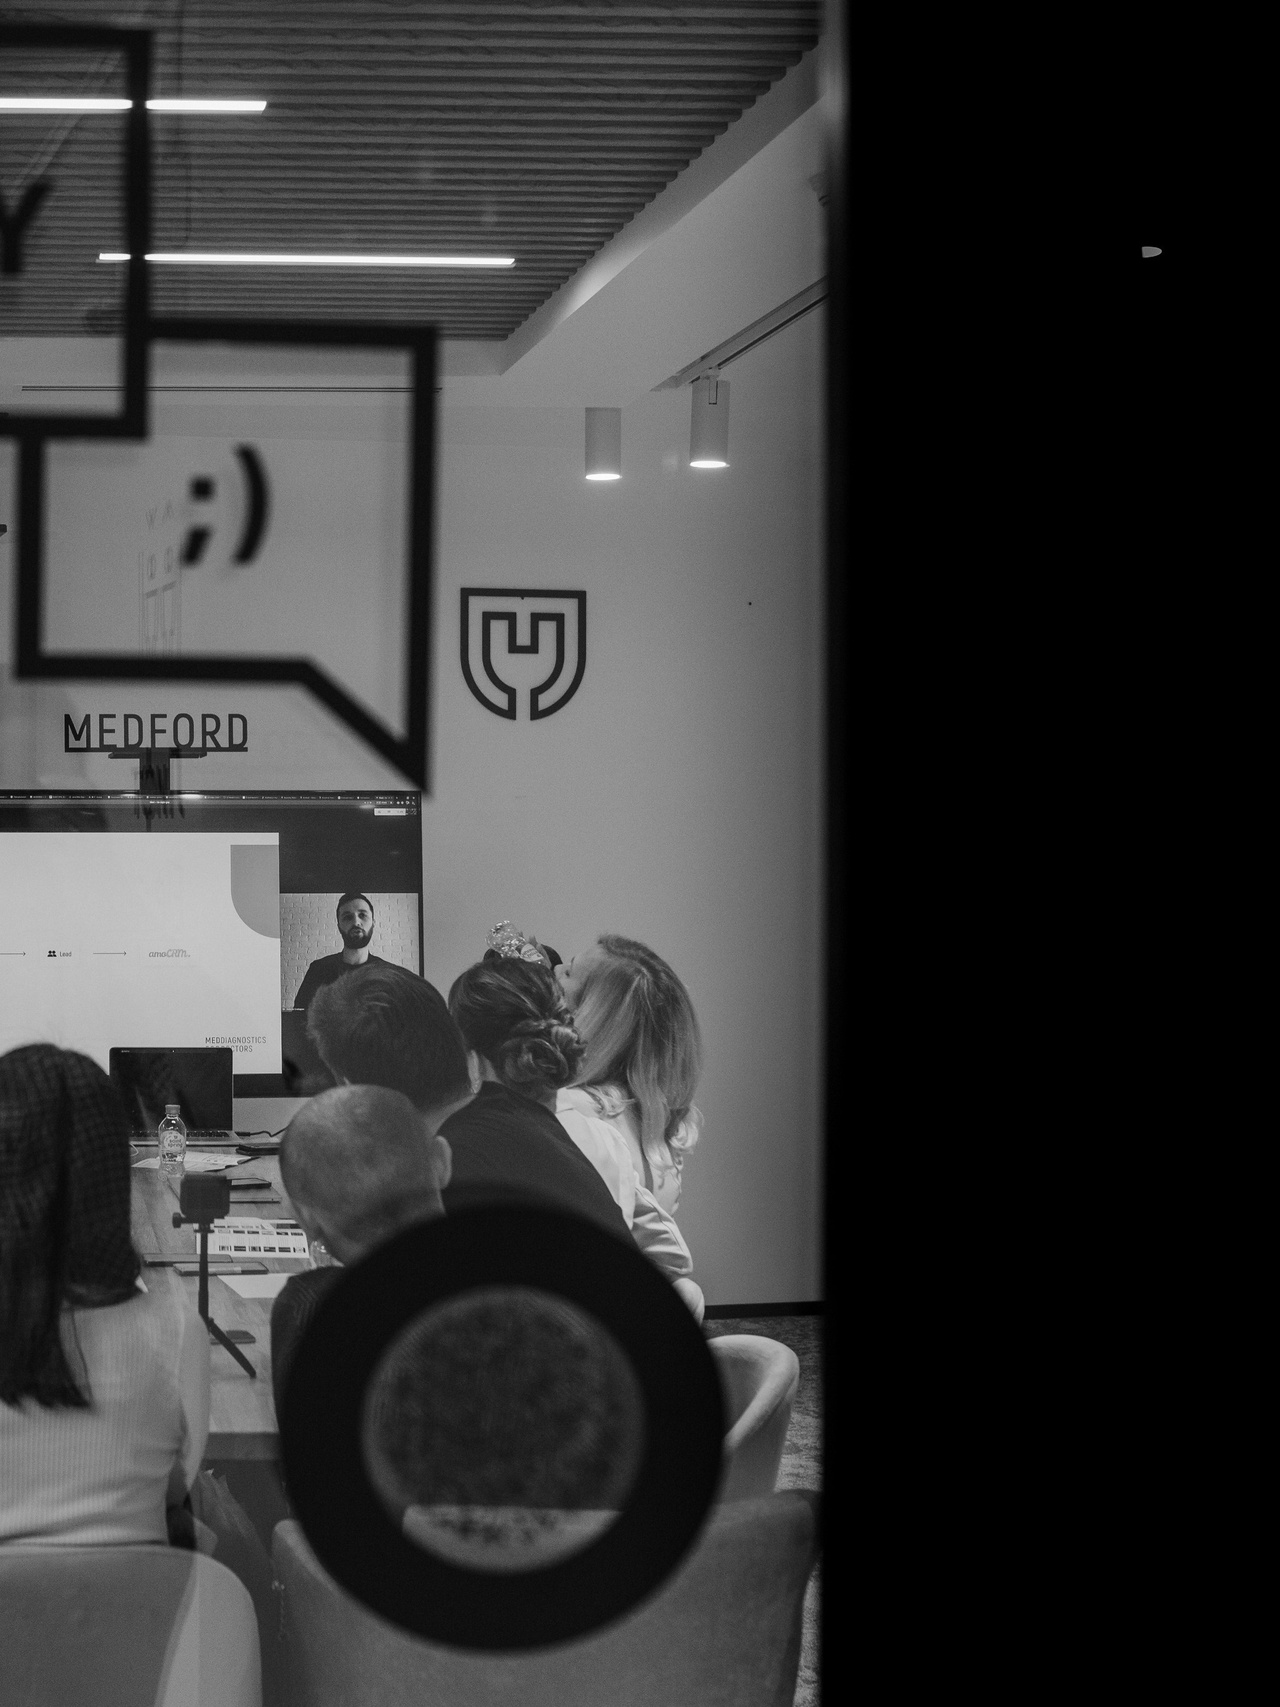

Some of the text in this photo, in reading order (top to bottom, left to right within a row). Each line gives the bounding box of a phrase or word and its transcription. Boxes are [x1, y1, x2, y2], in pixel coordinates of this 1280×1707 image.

[64, 713, 249, 750] MEDFORD
[59, 950, 73, 958] Lead
[205, 1036, 267, 1044] MEDDIAGNOSTICS
